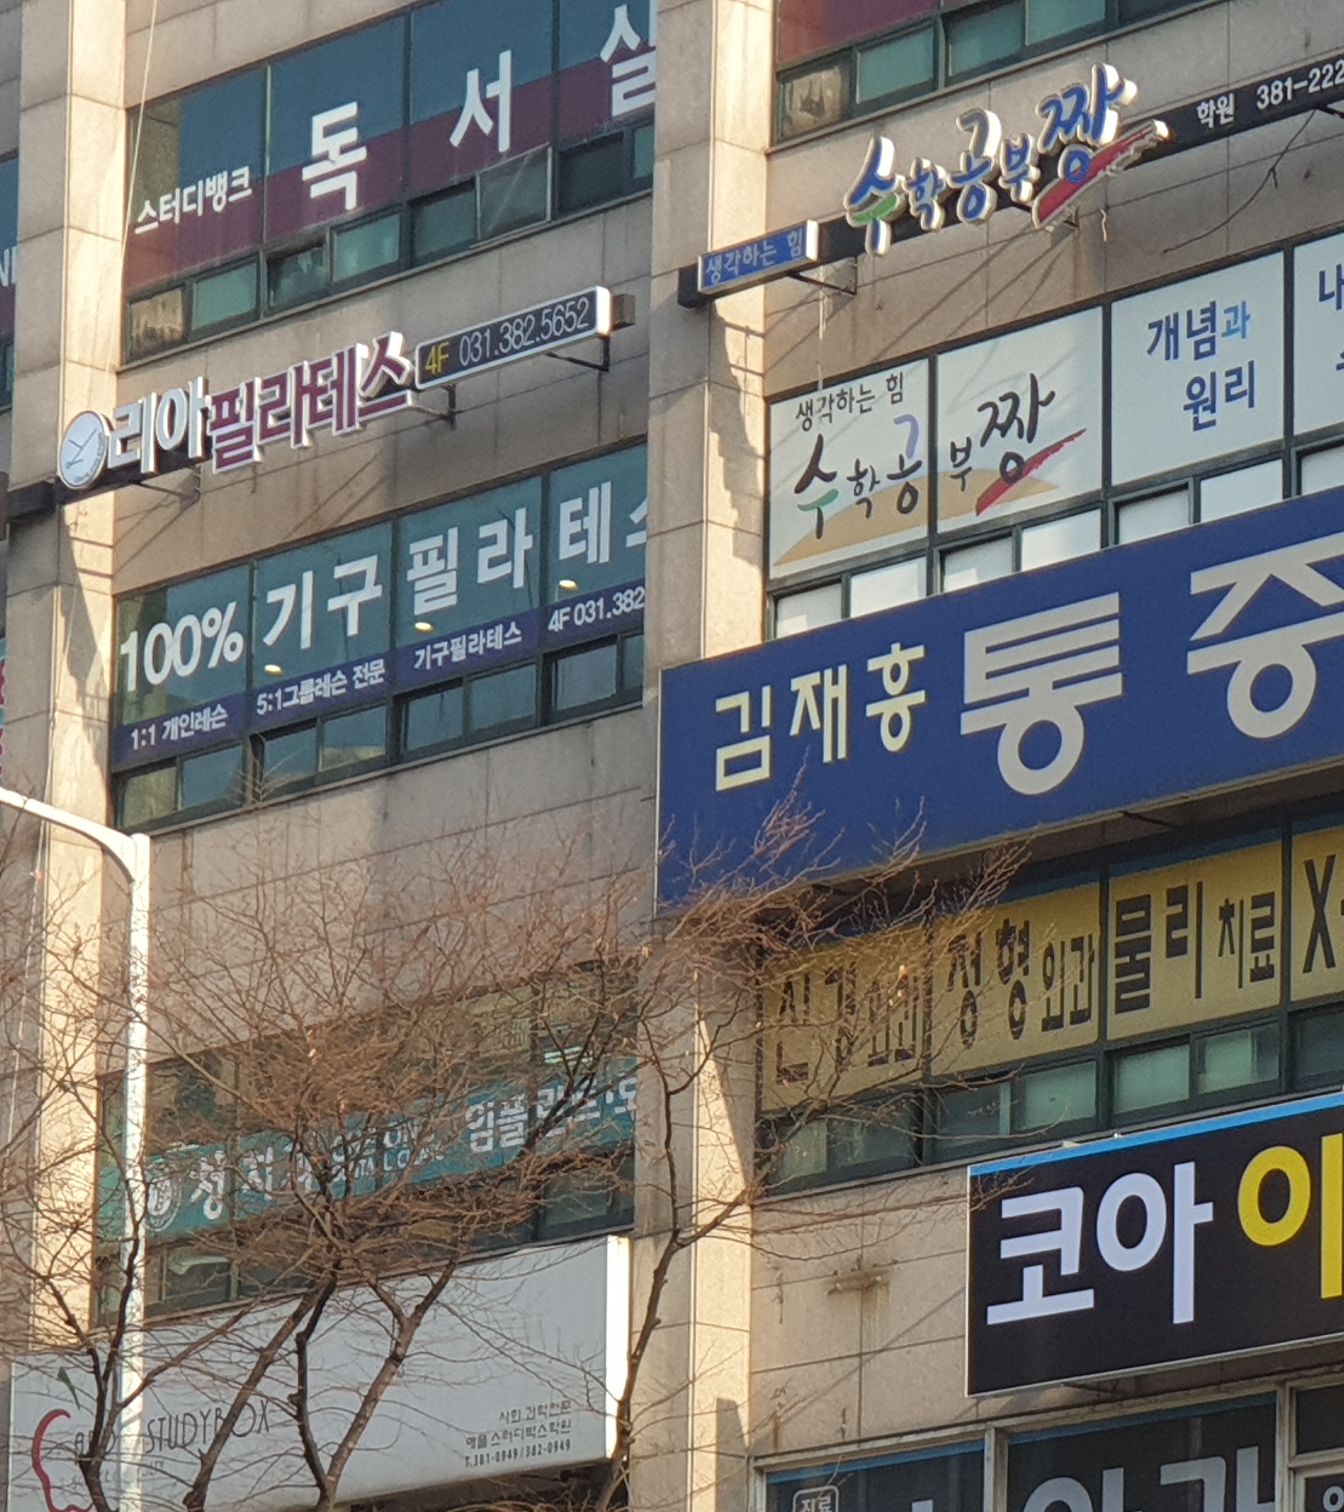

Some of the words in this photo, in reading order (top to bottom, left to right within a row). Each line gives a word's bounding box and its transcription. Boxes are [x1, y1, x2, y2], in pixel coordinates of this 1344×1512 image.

[1196, 96, 1236, 131] 학원
[134, 165, 252, 235] 스터디뱅크
[705, 240, 777, 283] 생각하는
[784, 230, 804, 261] 힘
[1146, 300, 1252, 362] 개념과
[108, 332, 414, 474] 리아필라테스
[424, 343, 450, 376] 4F
[458, 296, 591, 368] 031.382.5652
[795, 385, 873, 432] 생각하는
[885, 372, 905, 406] 힘
[1182, 366, 1257, 434] 원리
[120, 601, 245, 693] 100%
[262, 555, 384, 651] 기구
[130, 724, 157, 751] 1:1
[161, 702, 229, 744] 개인레슨
[351, 658, 386, 689] 전문
[414, 622, 523, 673] 기구필라테스
[548, 606, 573, 634] 4F
[715, 641, 926, 792] 김재홍
[1114, 882, 1276, 1016] 물리치료
[986, 1161, 1214, 1325] 코아
